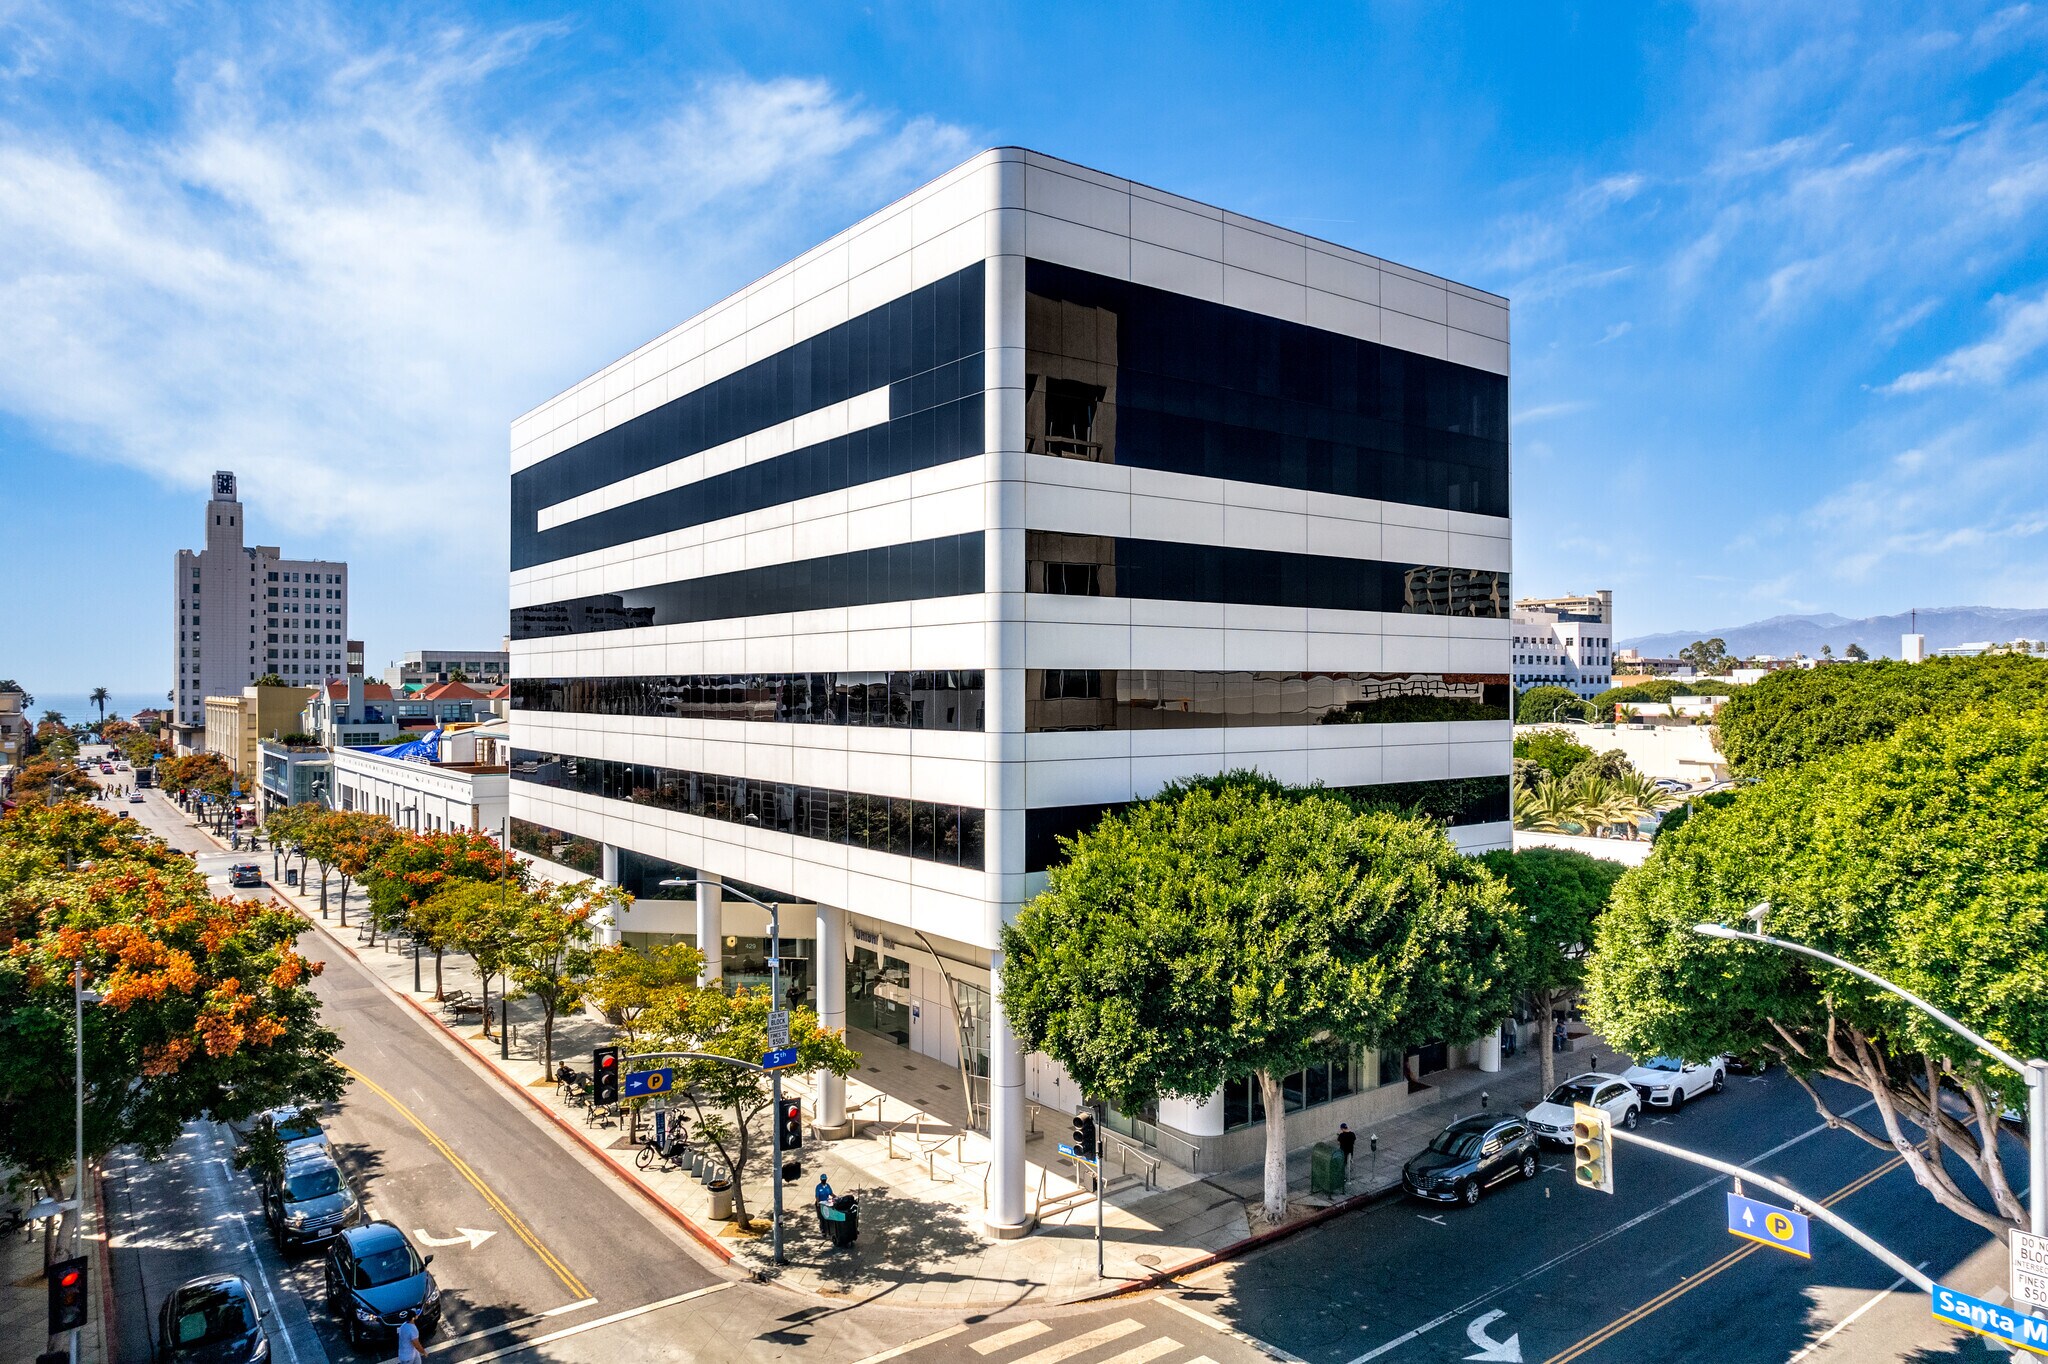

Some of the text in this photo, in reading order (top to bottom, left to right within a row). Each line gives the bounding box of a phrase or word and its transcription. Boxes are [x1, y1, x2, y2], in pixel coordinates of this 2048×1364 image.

[771, 1018, 785, 1026] BLOCK
[773, 1052, 786, 1063] 5th
[652, 1076, 660, 1087] P
[1774, 1217, 1787, 1234] P
[2021, 1236, 2035, 1249] DO
[2018, 1274, 2046, 1290] FINES
[2024, 1286, 2047, 1303] $50
[1939, 1291, 2014, 1333] Santa
